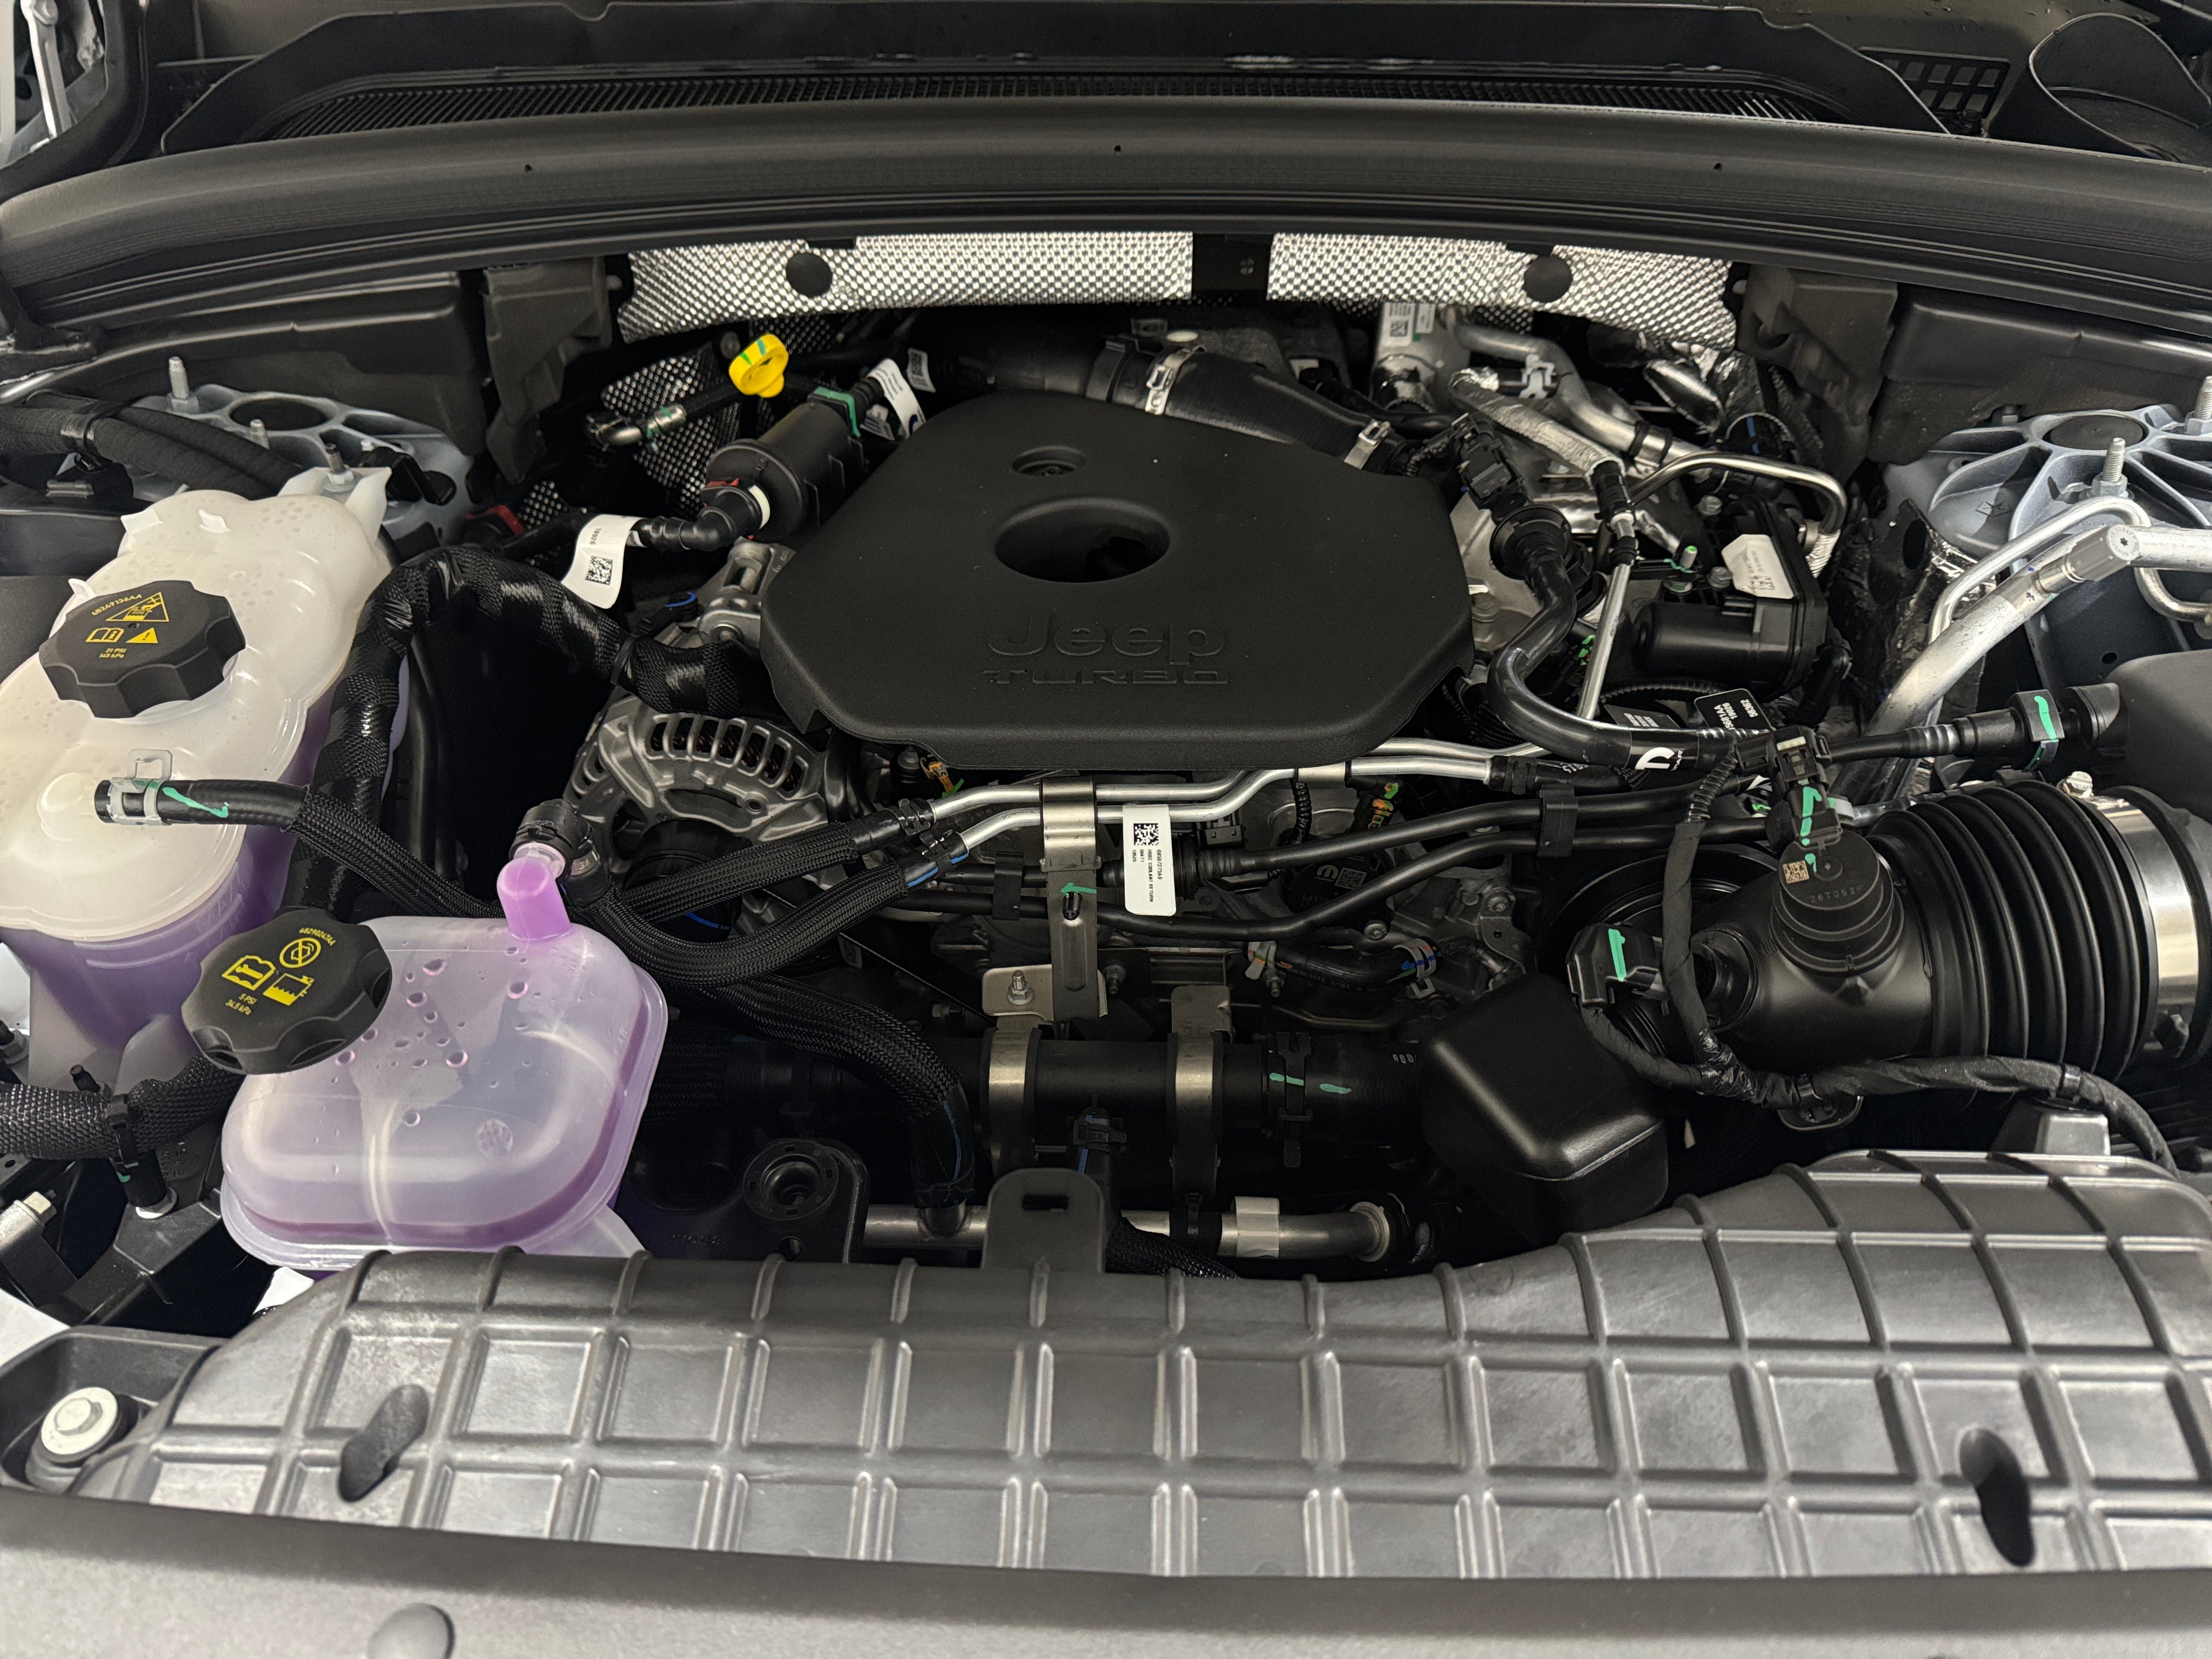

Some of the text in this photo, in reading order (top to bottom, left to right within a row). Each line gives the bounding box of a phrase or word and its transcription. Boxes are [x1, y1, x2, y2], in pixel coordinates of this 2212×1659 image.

[91, 594, 143, 616] 68249136AA
[988, 611, 1226, 665] Jeep
[981, 669, 1231, 685] TURBO
[244, 995, 257, 1005] PSI
